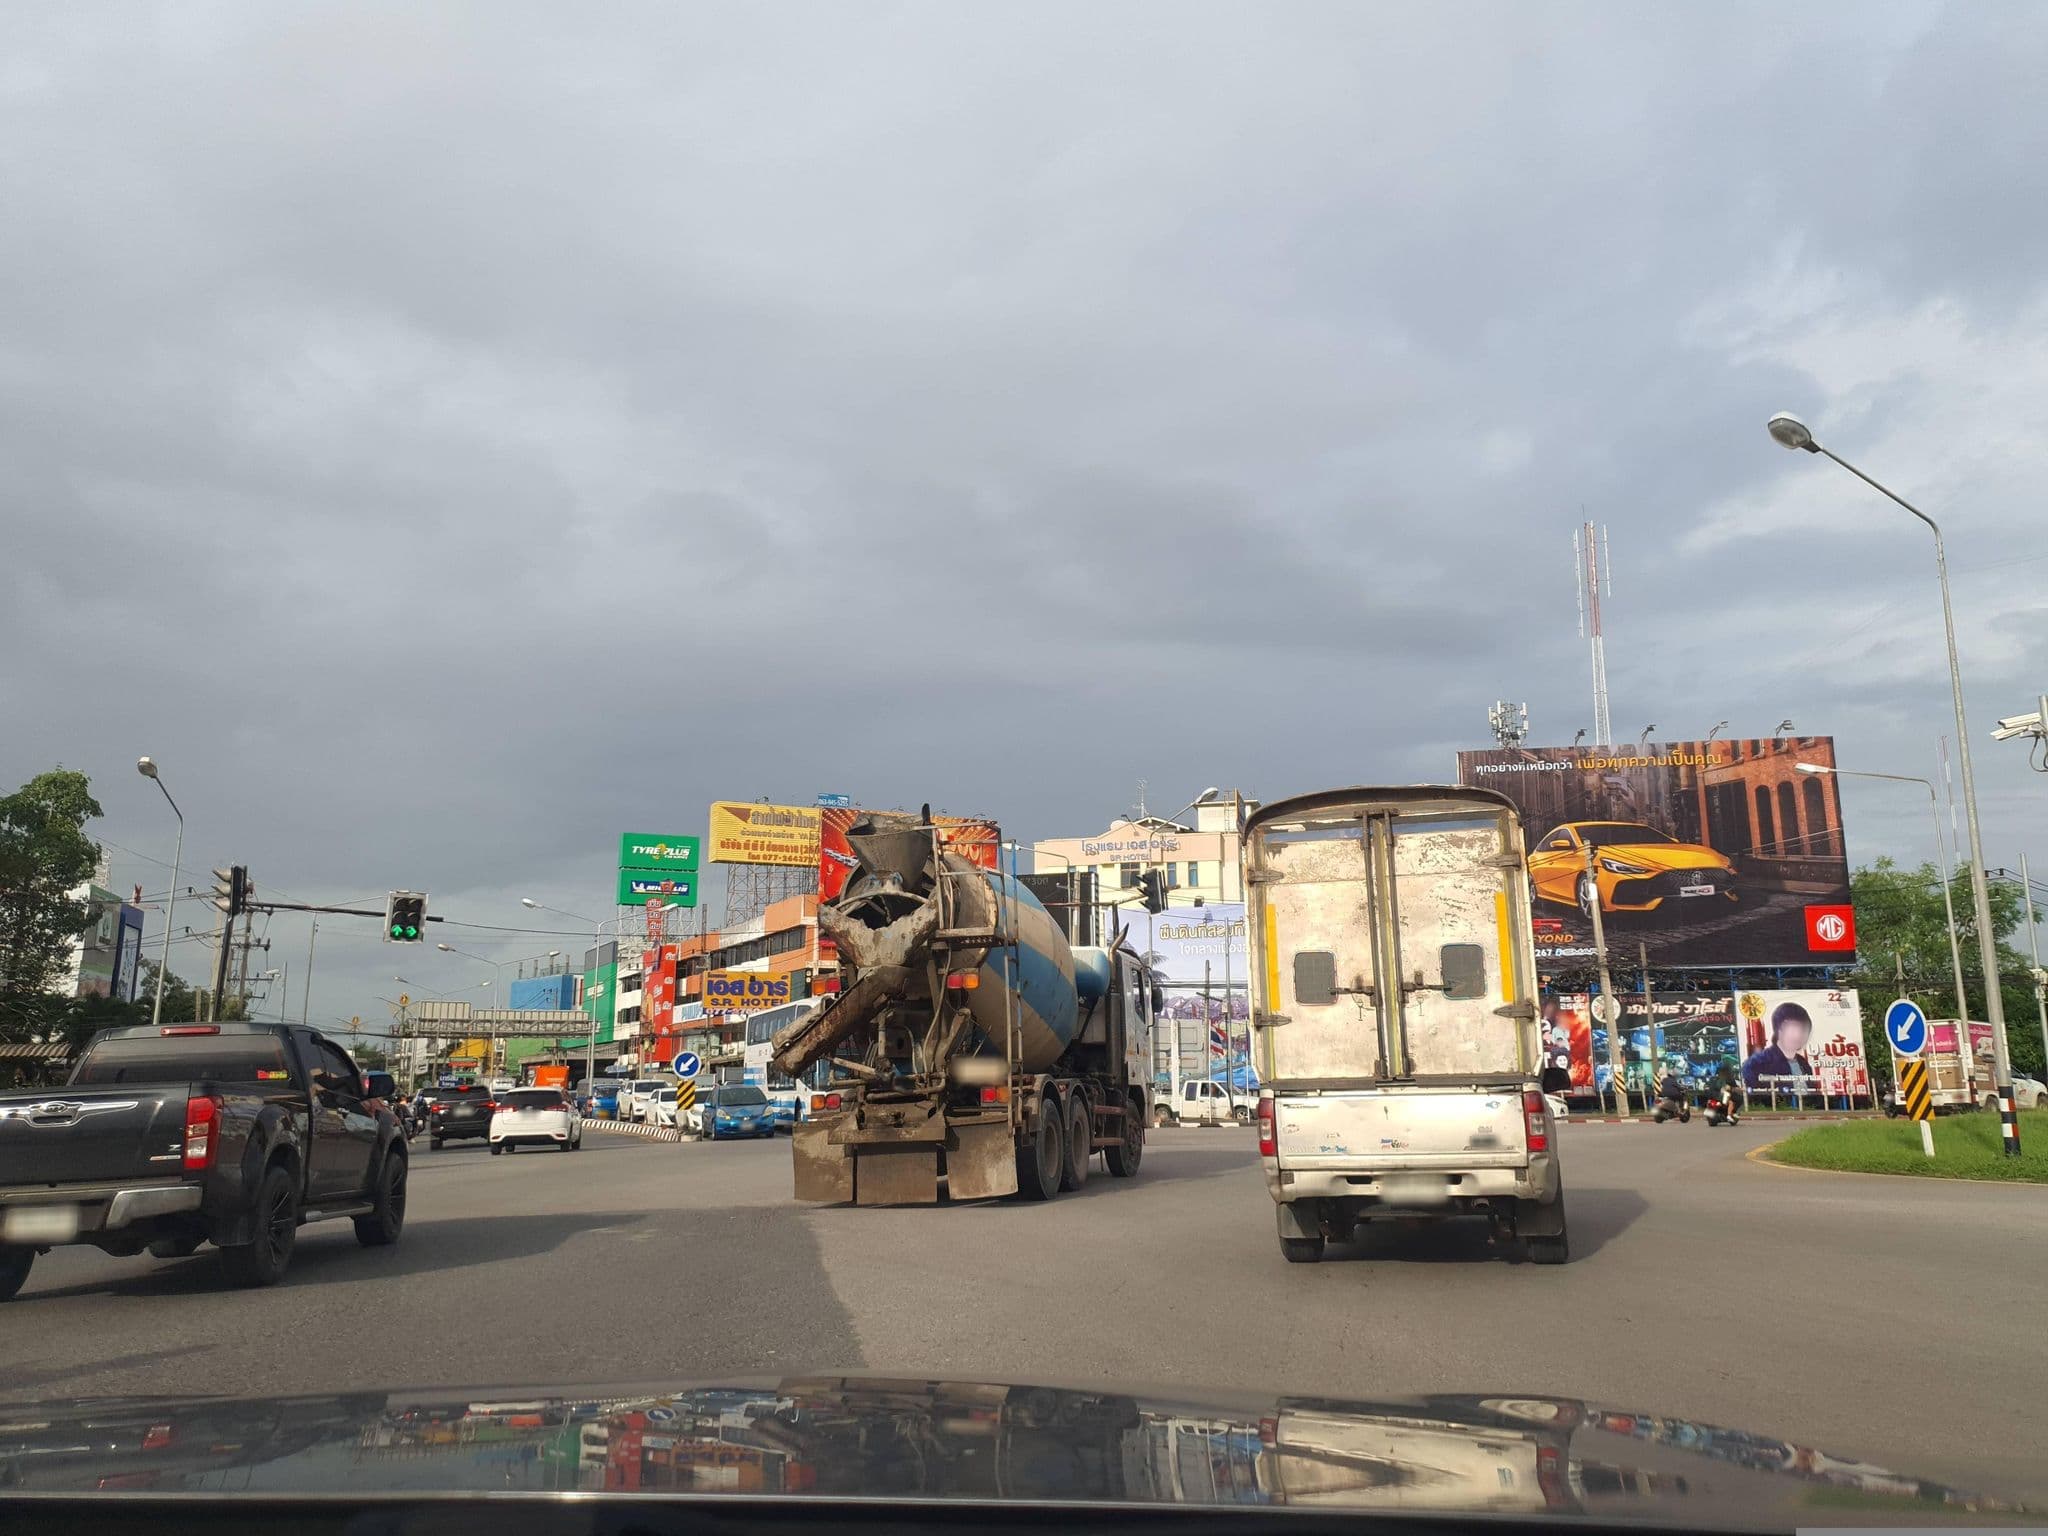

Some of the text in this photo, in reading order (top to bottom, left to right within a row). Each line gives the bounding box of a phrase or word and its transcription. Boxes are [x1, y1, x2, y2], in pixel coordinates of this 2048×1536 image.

[1577, 750, 1722, 773] เพื่อทุกความเป็นคุณ
[646, 884, 688, 893] MICLIN
[1819, 916, 1842, 939] MG
[1535, 934, 1574, 943] YOND
[707, 975, 789, 997] เอส อาร์
[710, 998, 735, 1006] S.R.
[1828, 993, 1842, 1002] 22
